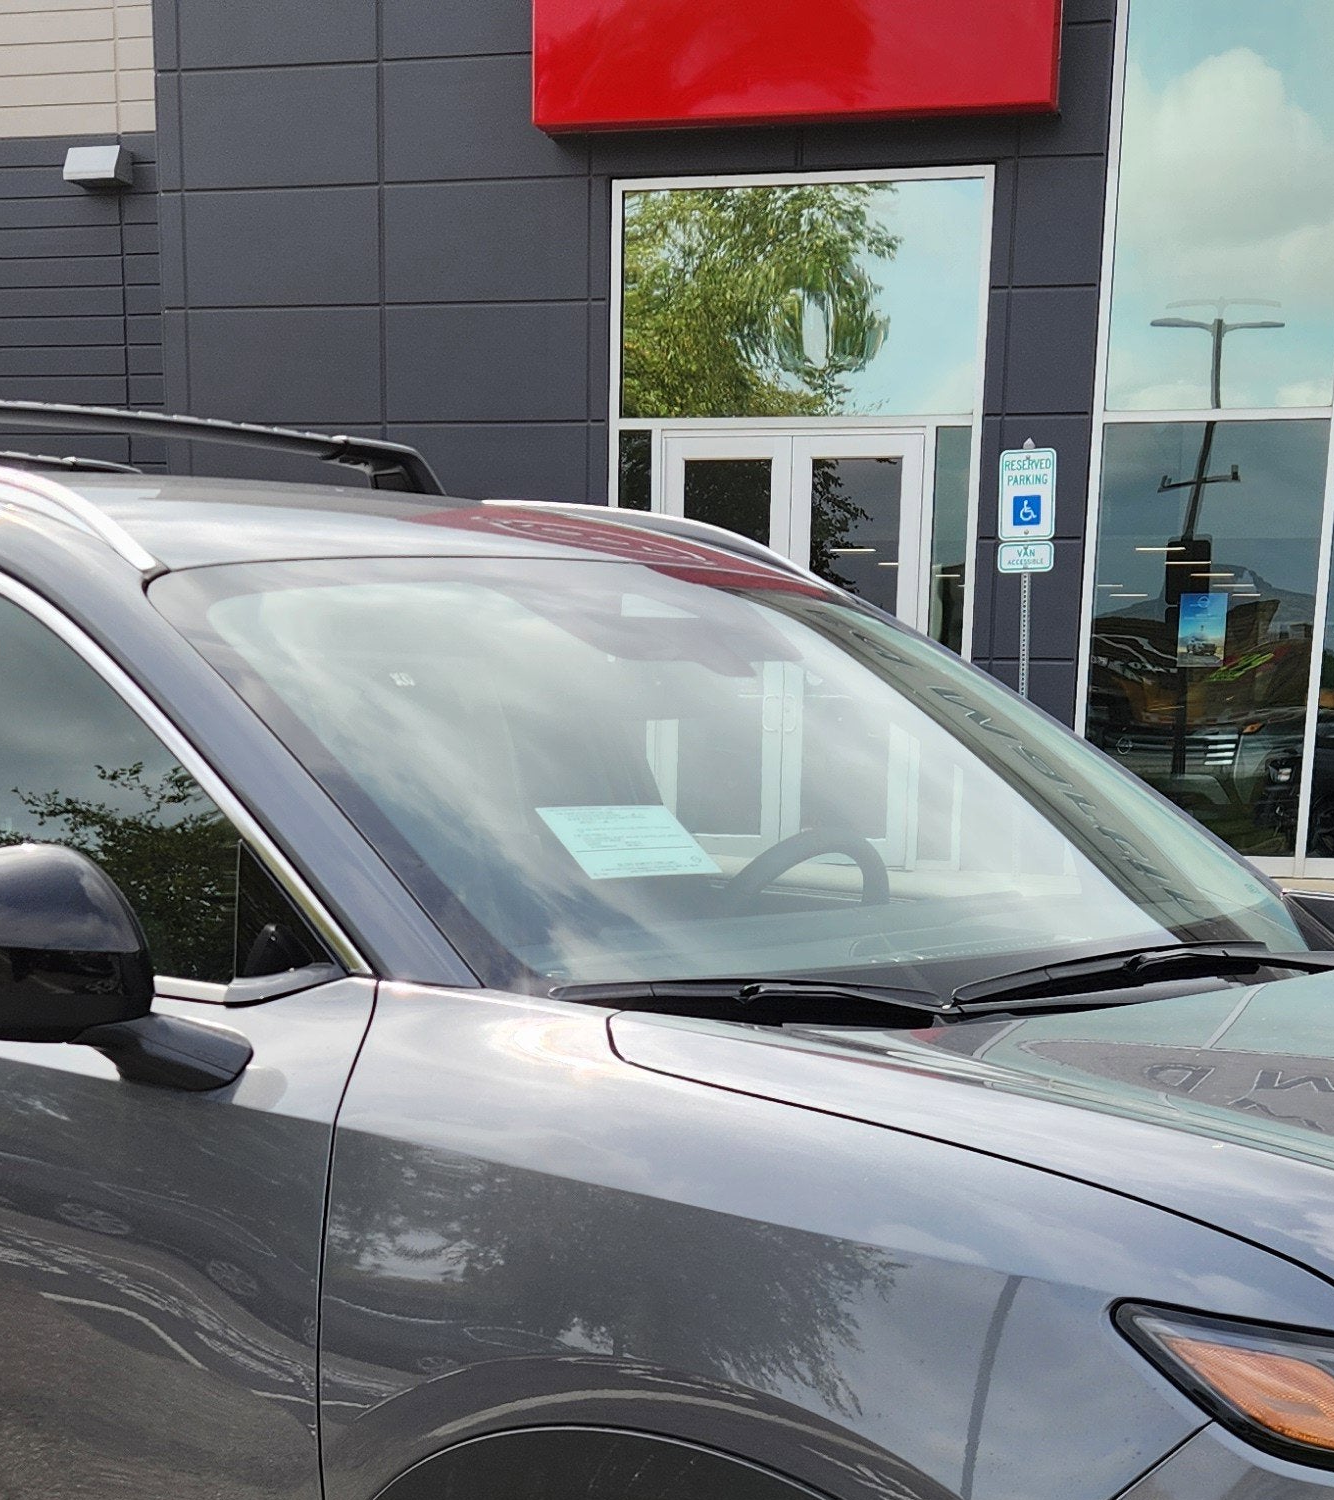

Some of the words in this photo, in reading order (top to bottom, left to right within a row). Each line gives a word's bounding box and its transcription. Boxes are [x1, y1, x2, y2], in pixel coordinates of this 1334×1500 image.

[1004, 457, 1052, 472] RESERVED
[1007, 474, 1048, 487] PARKING
[1016, 548, 1036, 558] VAN
[1007, 557, 1044, 566] ACCESSIBLE
